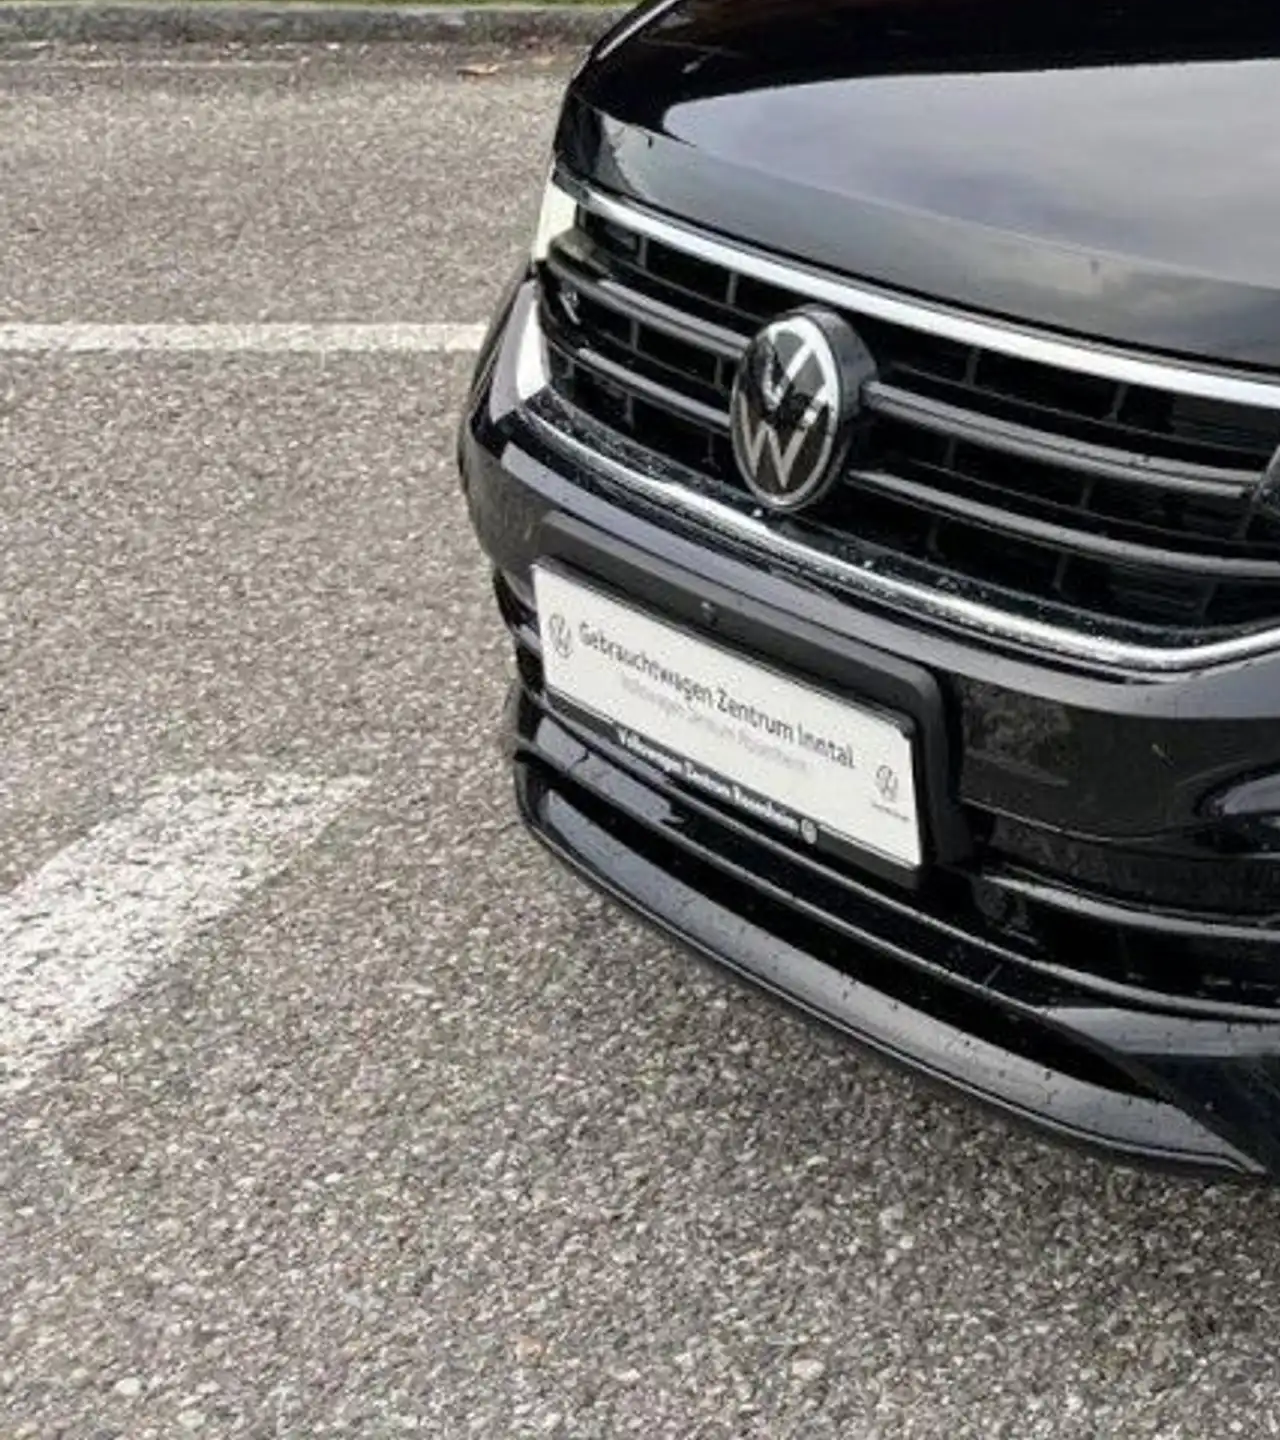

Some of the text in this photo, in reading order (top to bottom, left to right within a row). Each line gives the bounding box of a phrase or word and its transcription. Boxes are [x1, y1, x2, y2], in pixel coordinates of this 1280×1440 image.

[577, 619, 715, 707] Gebrauchtwagen
[714, 685, 795, 744] Zentrum
[797, 721, 857, 770] Inntal
